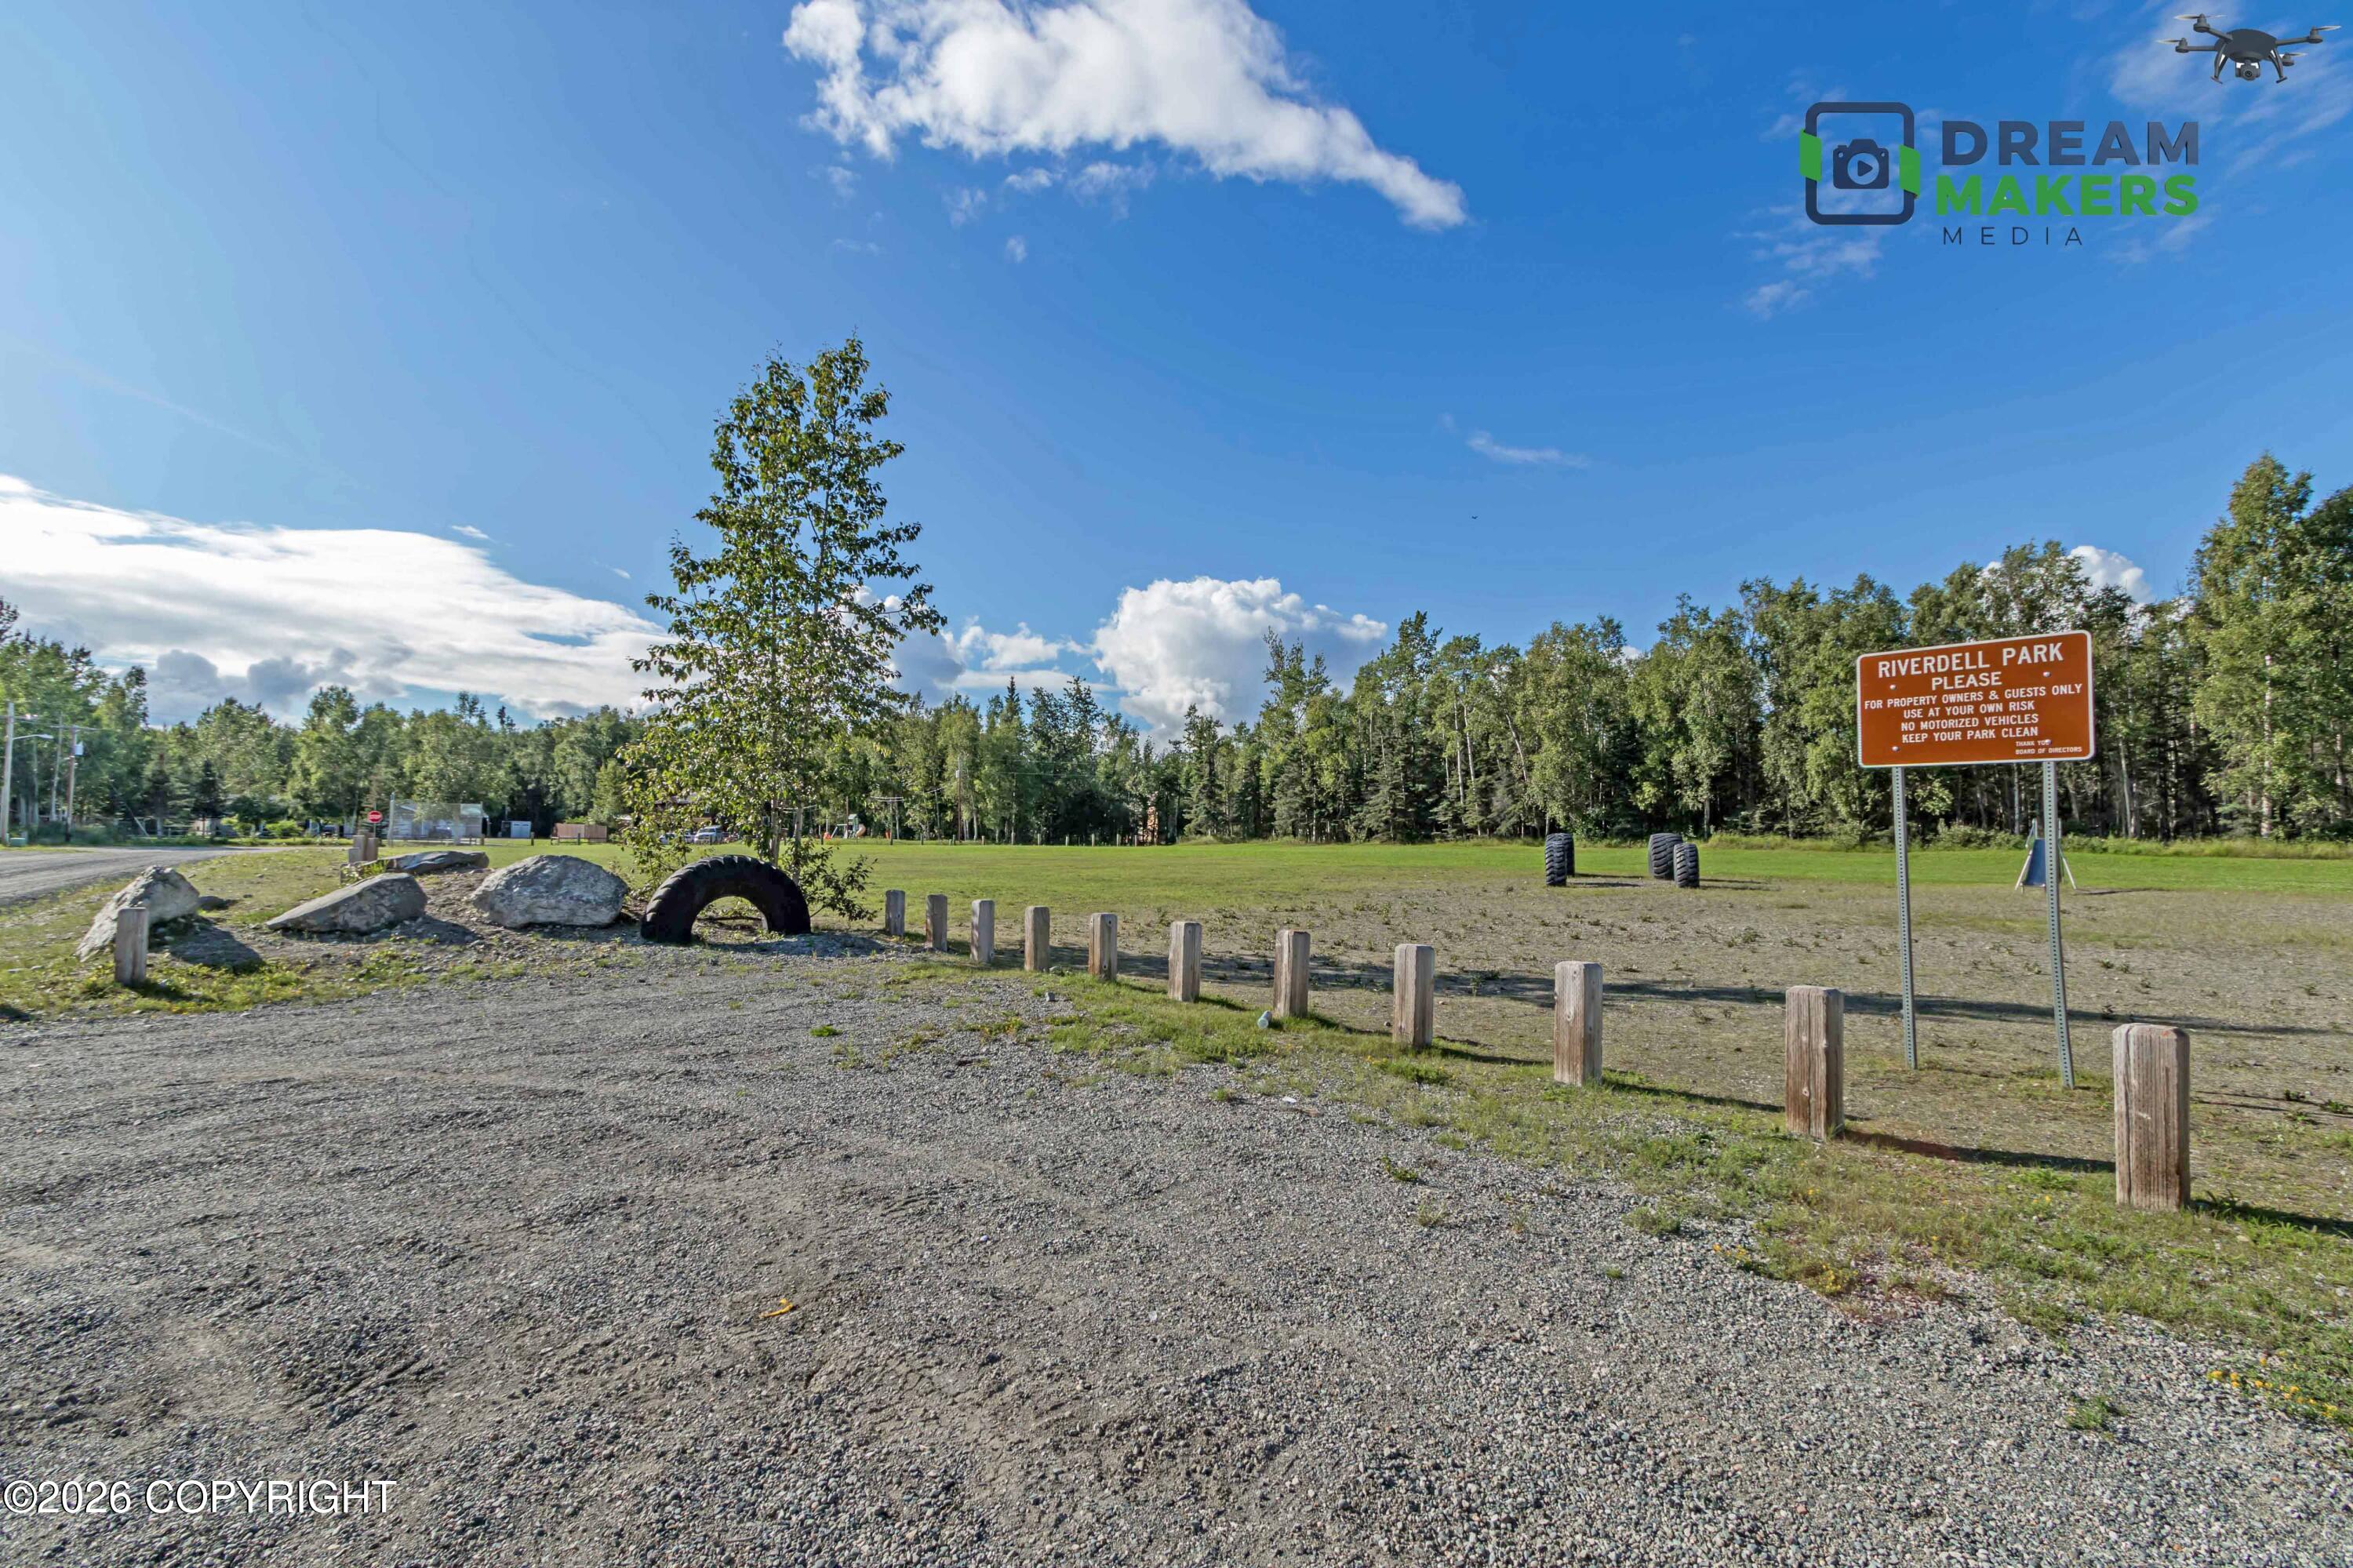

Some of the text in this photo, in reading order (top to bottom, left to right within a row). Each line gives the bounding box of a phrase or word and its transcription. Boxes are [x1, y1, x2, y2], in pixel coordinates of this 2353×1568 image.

[1878, 642, 2064, 678] RIVERDELL PARK
[1931, 671, 2002, 690] PLEASE
[1864, 683, 2082, 710] FOR PROPERTY OWNERS & GUESTS ONLY
[1903, 700, 2035, 719] USE AT YOUR OWN RISK
[1901, 713, 2039, 731] NO MOTORIZED VEHICLES
[1902, 726, 2038, 744] KEEP YOUR PARK CLEAN
